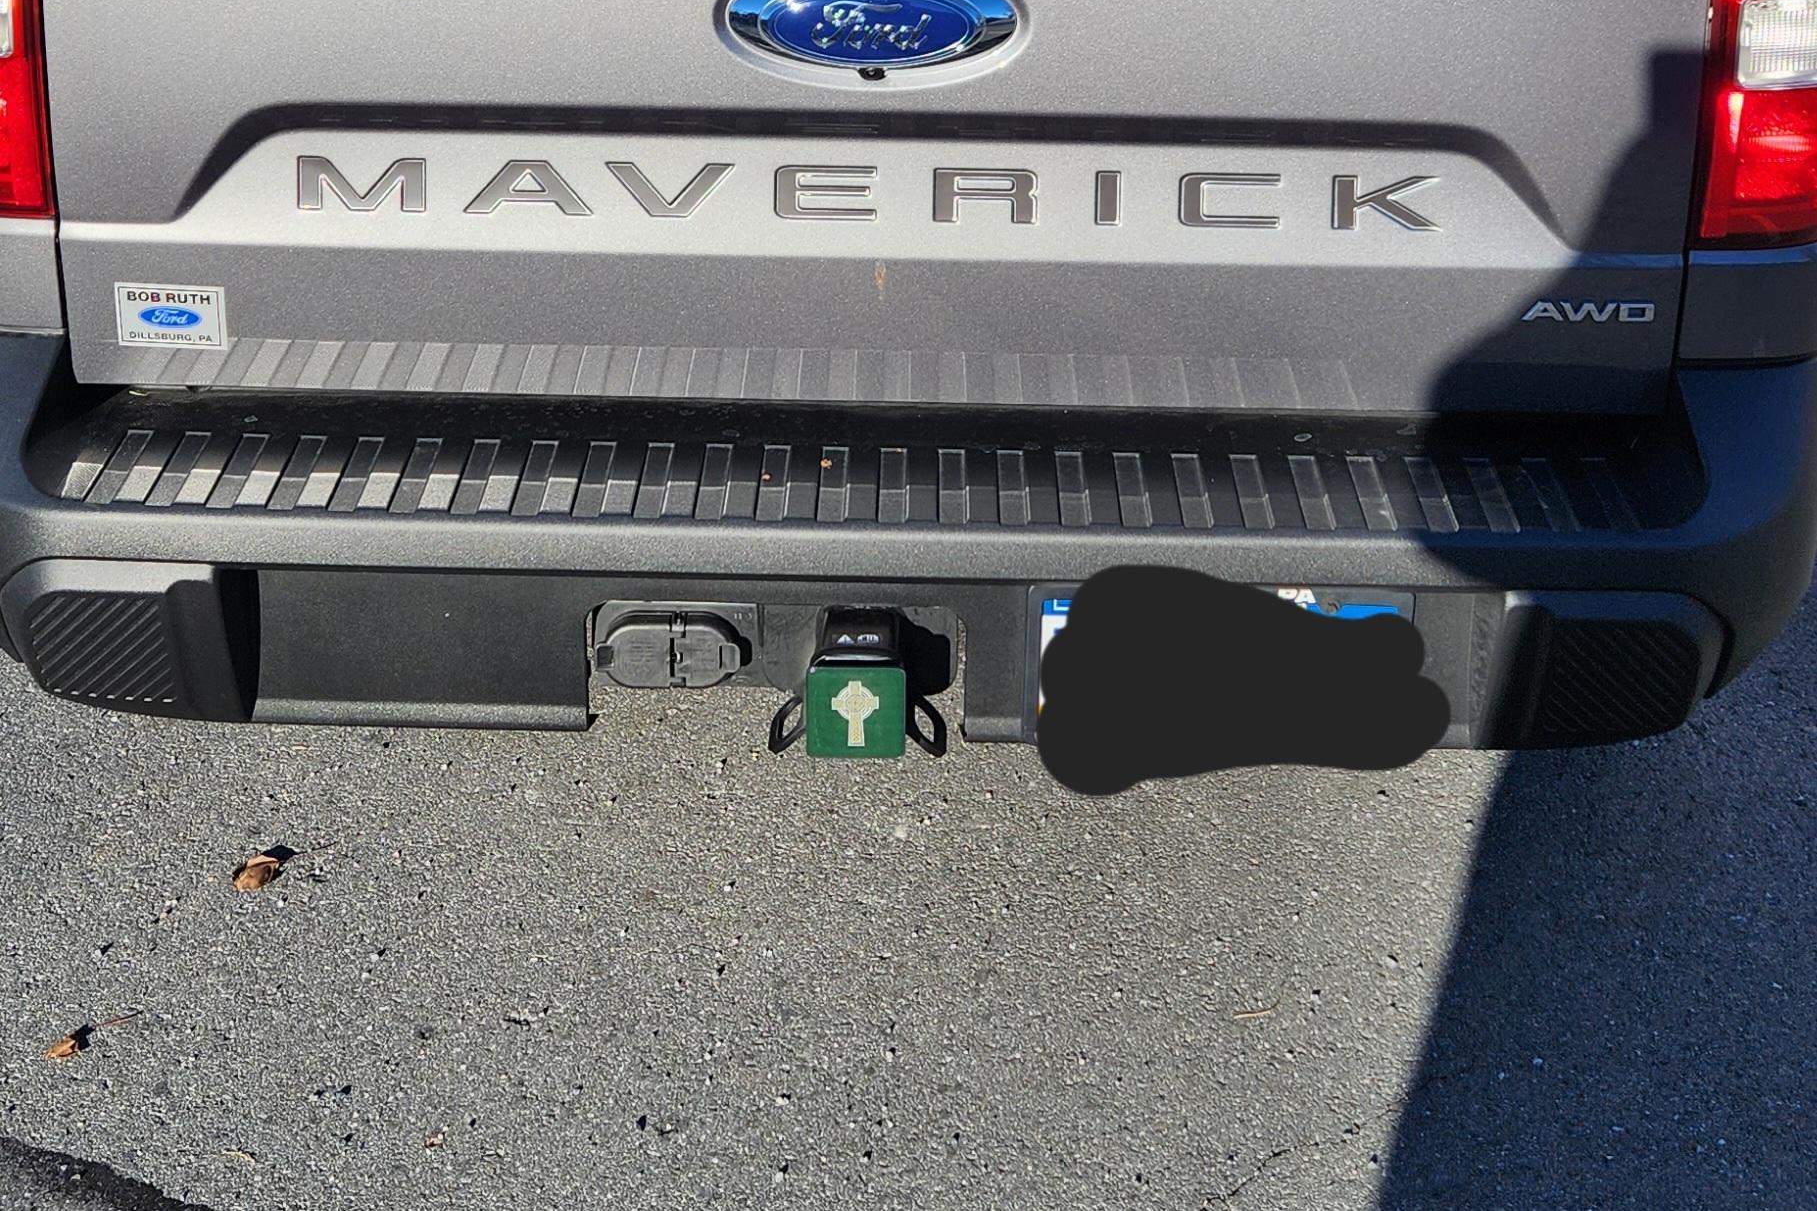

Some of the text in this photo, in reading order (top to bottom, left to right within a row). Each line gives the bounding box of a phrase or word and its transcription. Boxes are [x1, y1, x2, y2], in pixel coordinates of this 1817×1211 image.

[810, 0, 932, 50] Ford
[296, 154, 1443, 233] MAVERICK
[126, 290, 212, 305] BOB RUTH
[151, 307, 190, 326] Ford
[1520, 300, 1656, 322] AWD
[128, 331, 213, 343] DILLSBURG, PA
